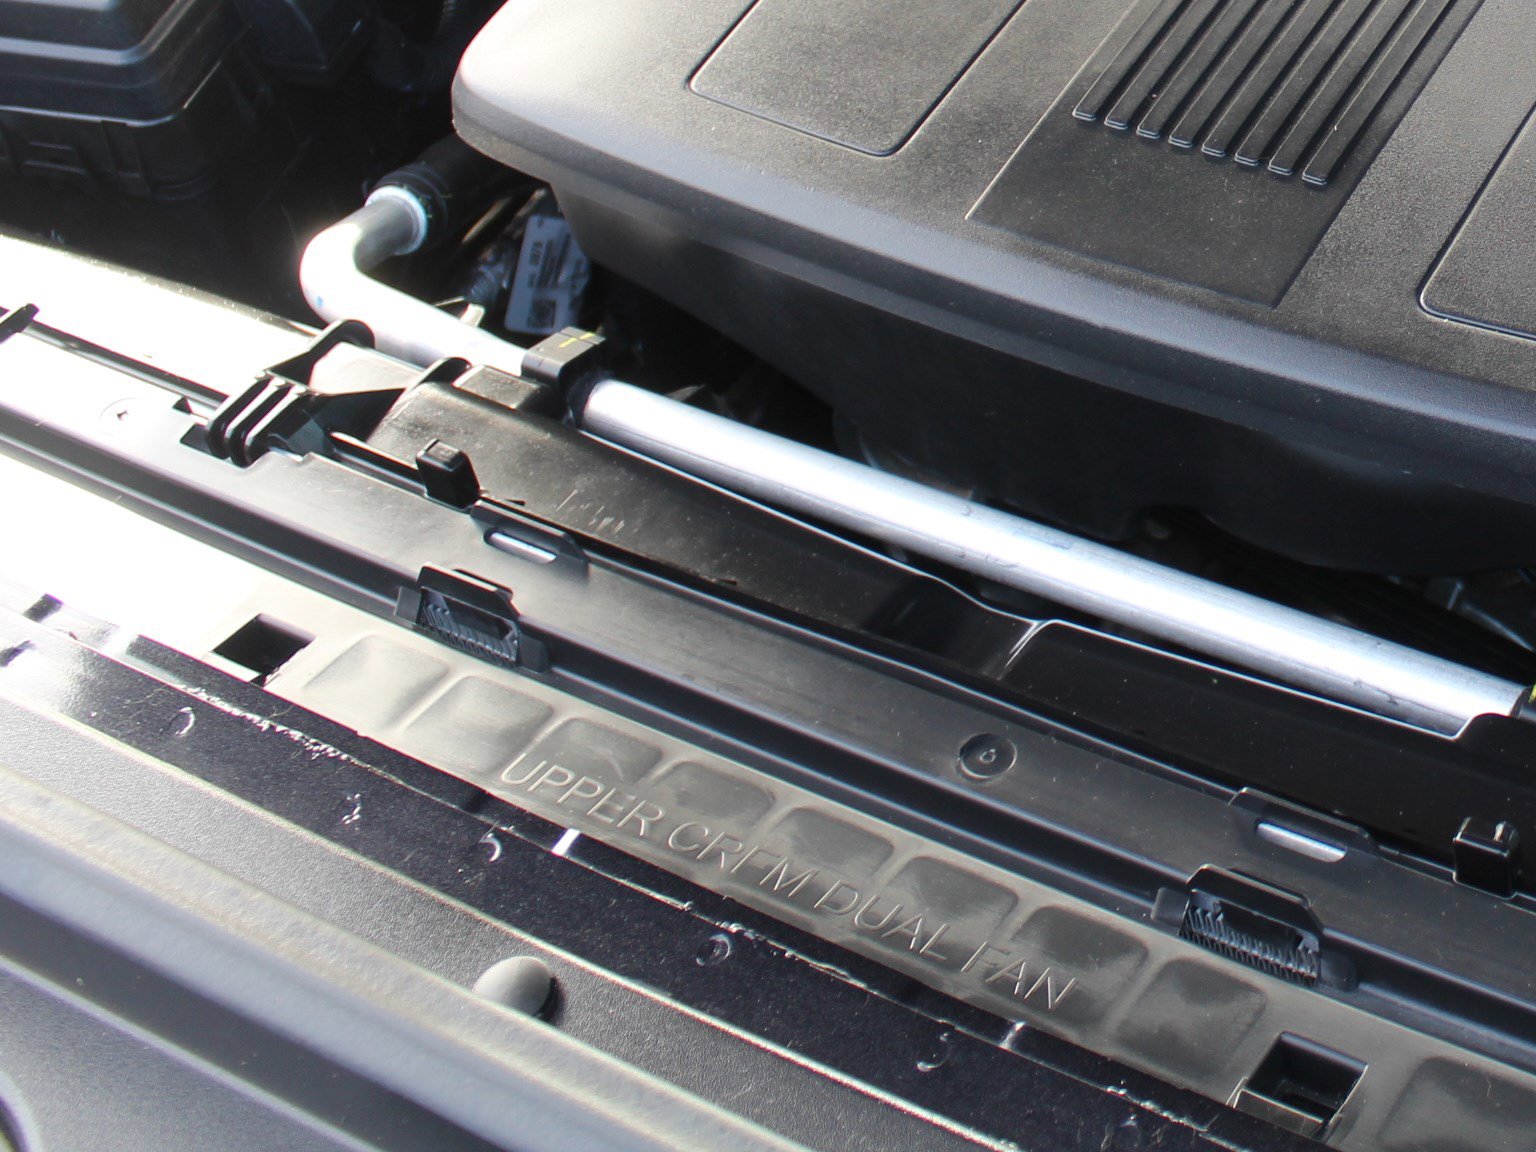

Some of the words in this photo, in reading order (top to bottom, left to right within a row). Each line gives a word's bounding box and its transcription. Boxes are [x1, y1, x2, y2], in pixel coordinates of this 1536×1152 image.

[500, 752, 666, 837] UPPER
[667, 821, 821, 898] CRFM
[813, 879, 951, 961] DUAL
[960, 940, 1078, 1010] FAN
